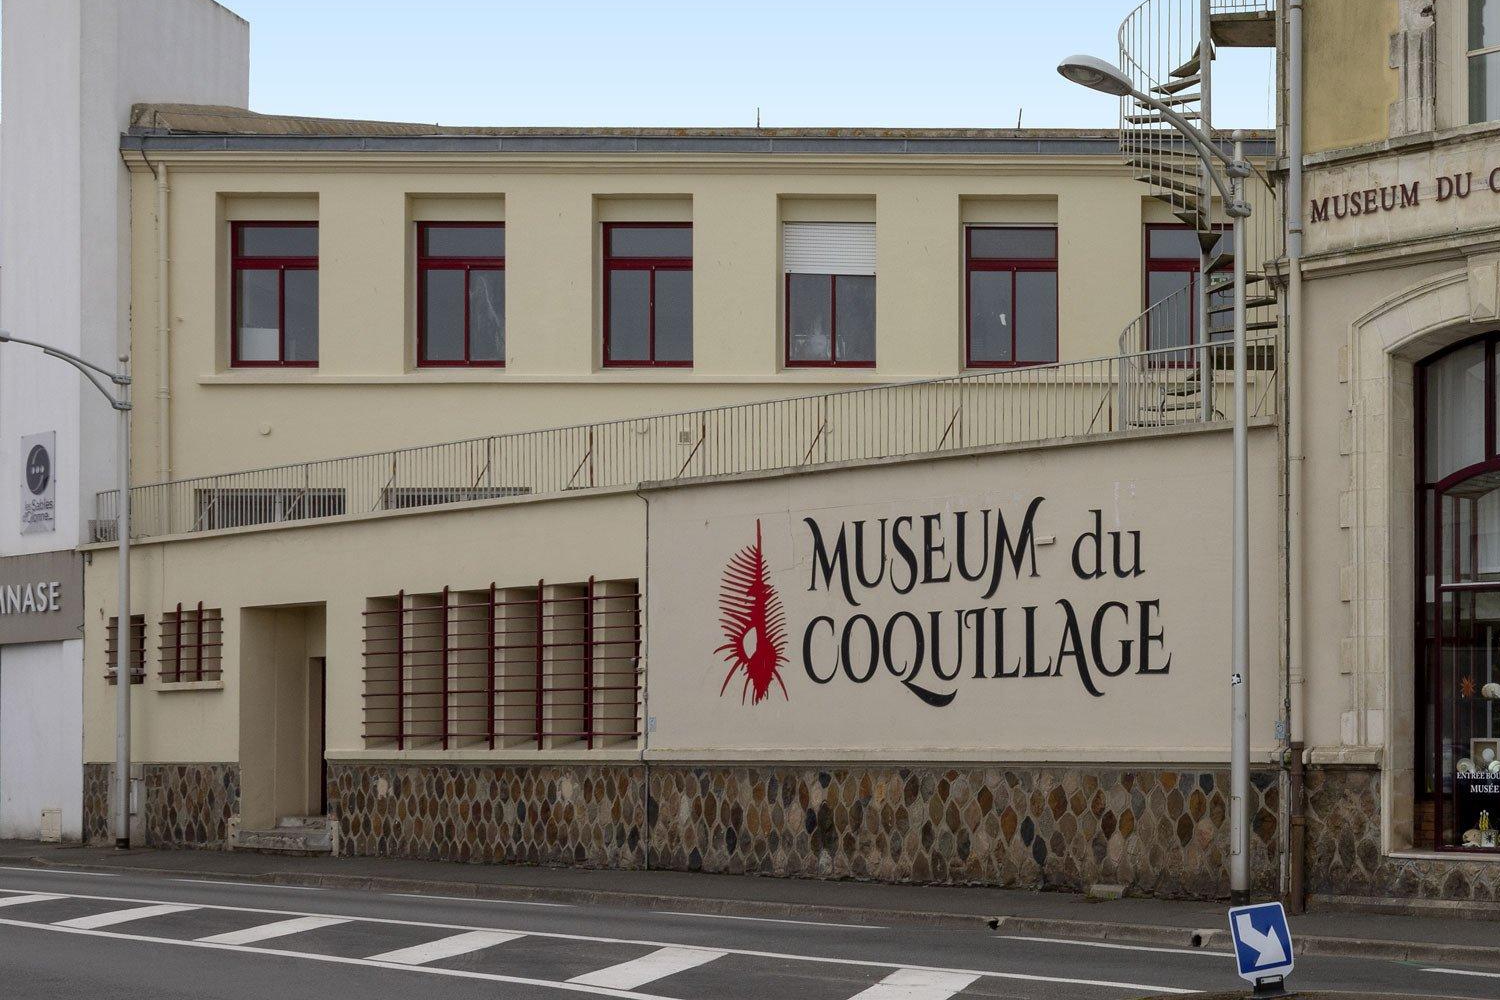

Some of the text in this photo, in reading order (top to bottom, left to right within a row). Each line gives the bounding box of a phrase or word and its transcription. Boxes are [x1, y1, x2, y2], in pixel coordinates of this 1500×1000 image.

[1310, 181, 1420, 224] MUSEUM
[1435, 171, 1473, 203] DU
[32, 498, 53, 513] Sables
[803, 496, 1145, 606] MUSEUM du
[803, 597, 1172, 707] COQUILLAGE
[1457, 771, 1486, 780] ENTRÉE
[1470, 783, 1500, 794] MUSÉE
